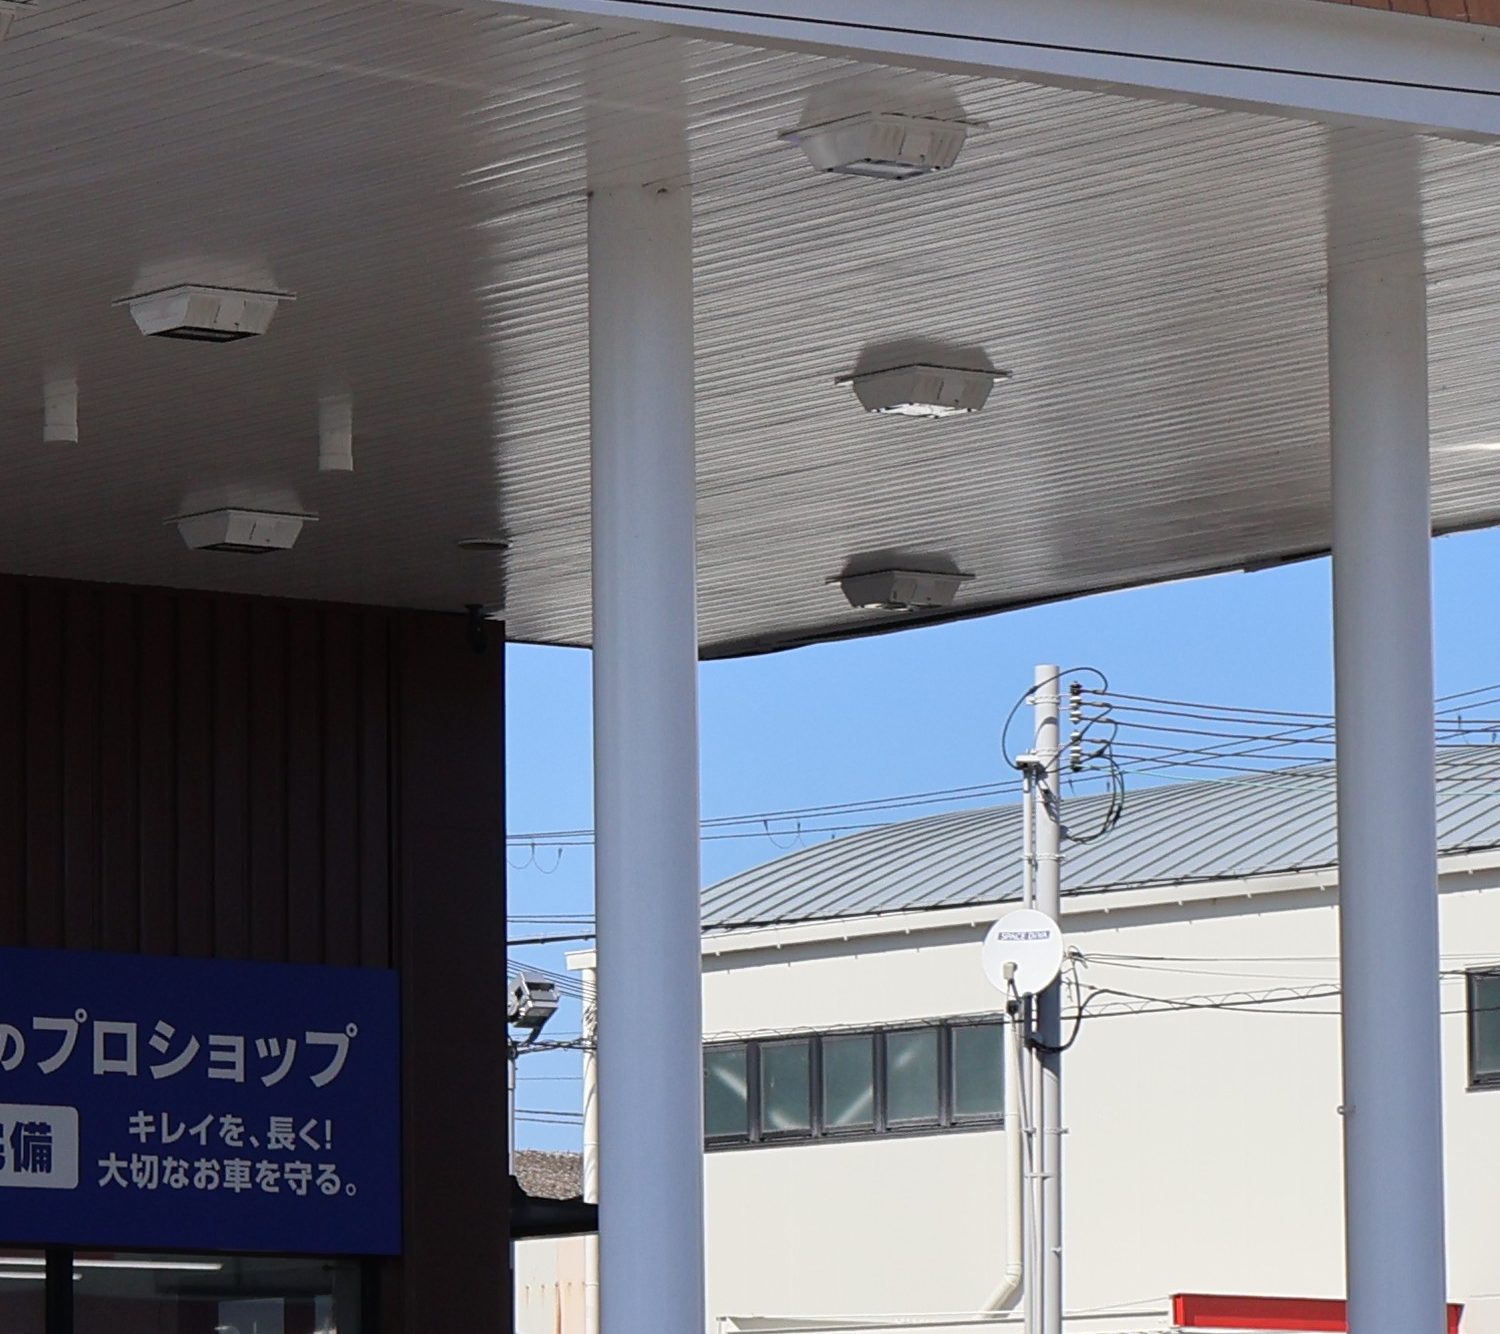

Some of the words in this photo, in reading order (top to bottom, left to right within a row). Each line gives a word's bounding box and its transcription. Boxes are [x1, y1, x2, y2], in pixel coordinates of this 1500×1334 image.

[98, 1152, 357, 1197] 大切なお車を守る。
